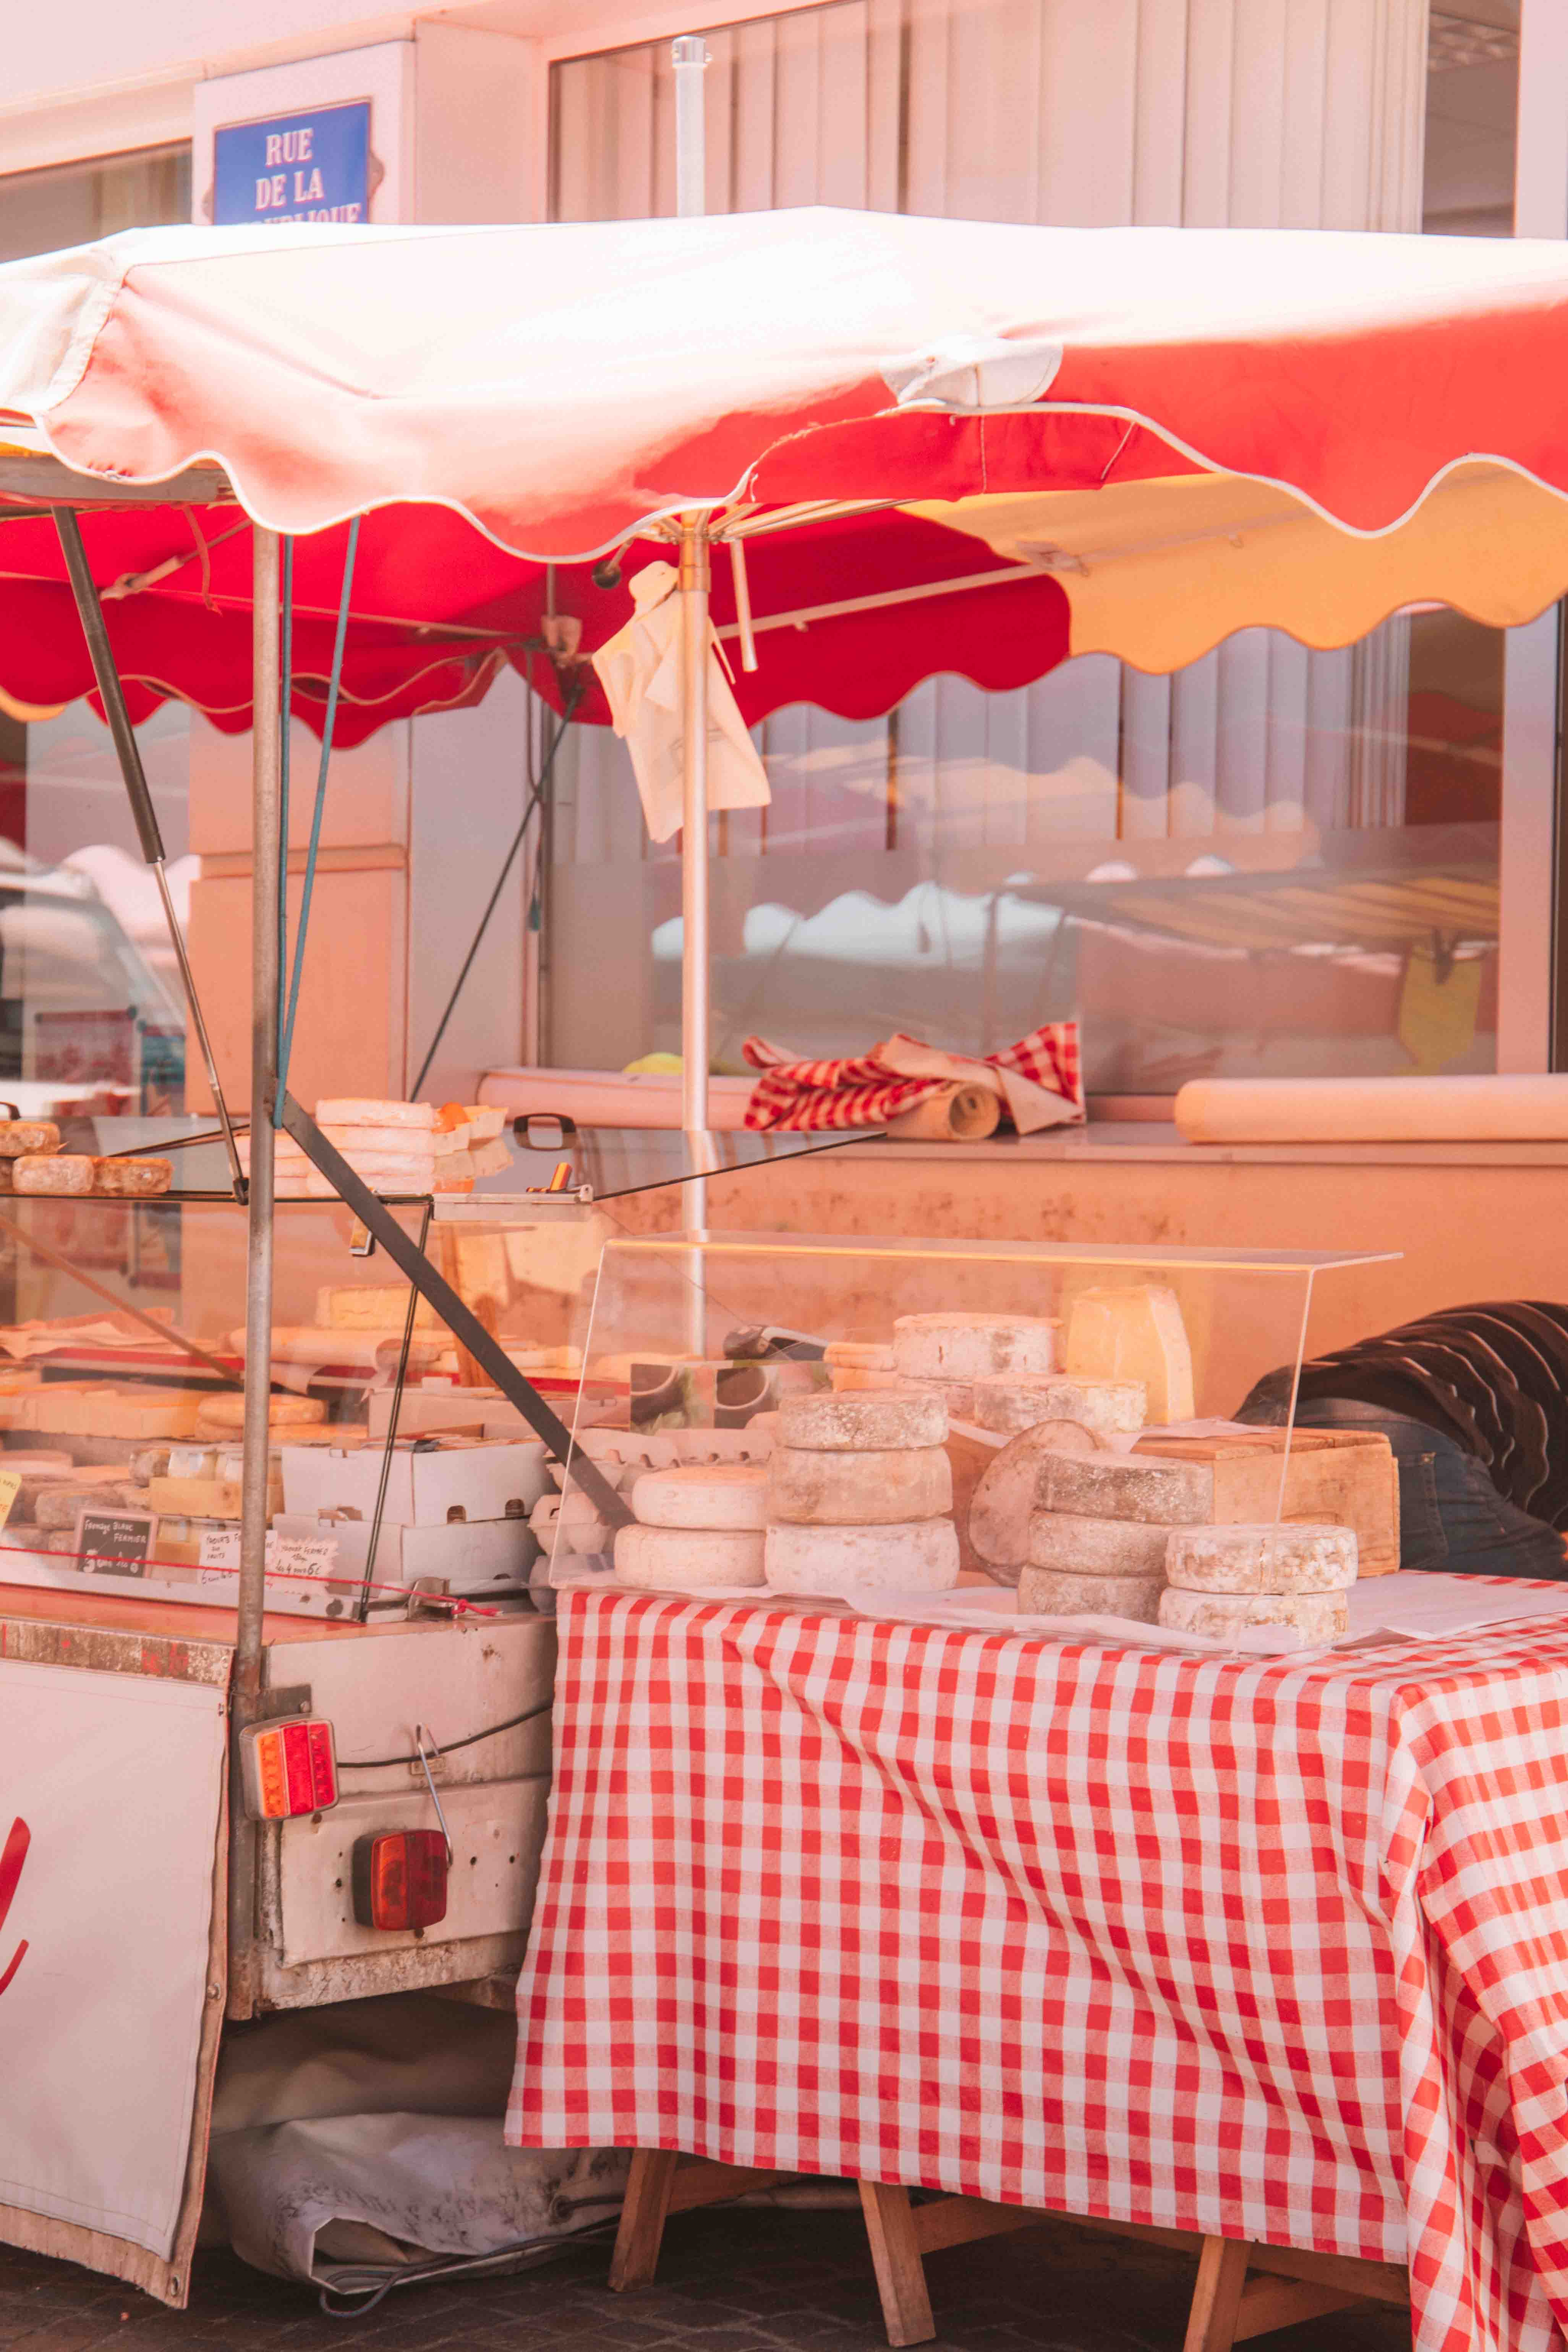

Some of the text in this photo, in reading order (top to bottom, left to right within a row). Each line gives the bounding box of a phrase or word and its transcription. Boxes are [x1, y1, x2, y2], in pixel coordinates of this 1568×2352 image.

[265, 128, 313, 167] RUE
[256, 167, 324, 211] DE LA
[114, 1533, 146, 1543] FERMIER
